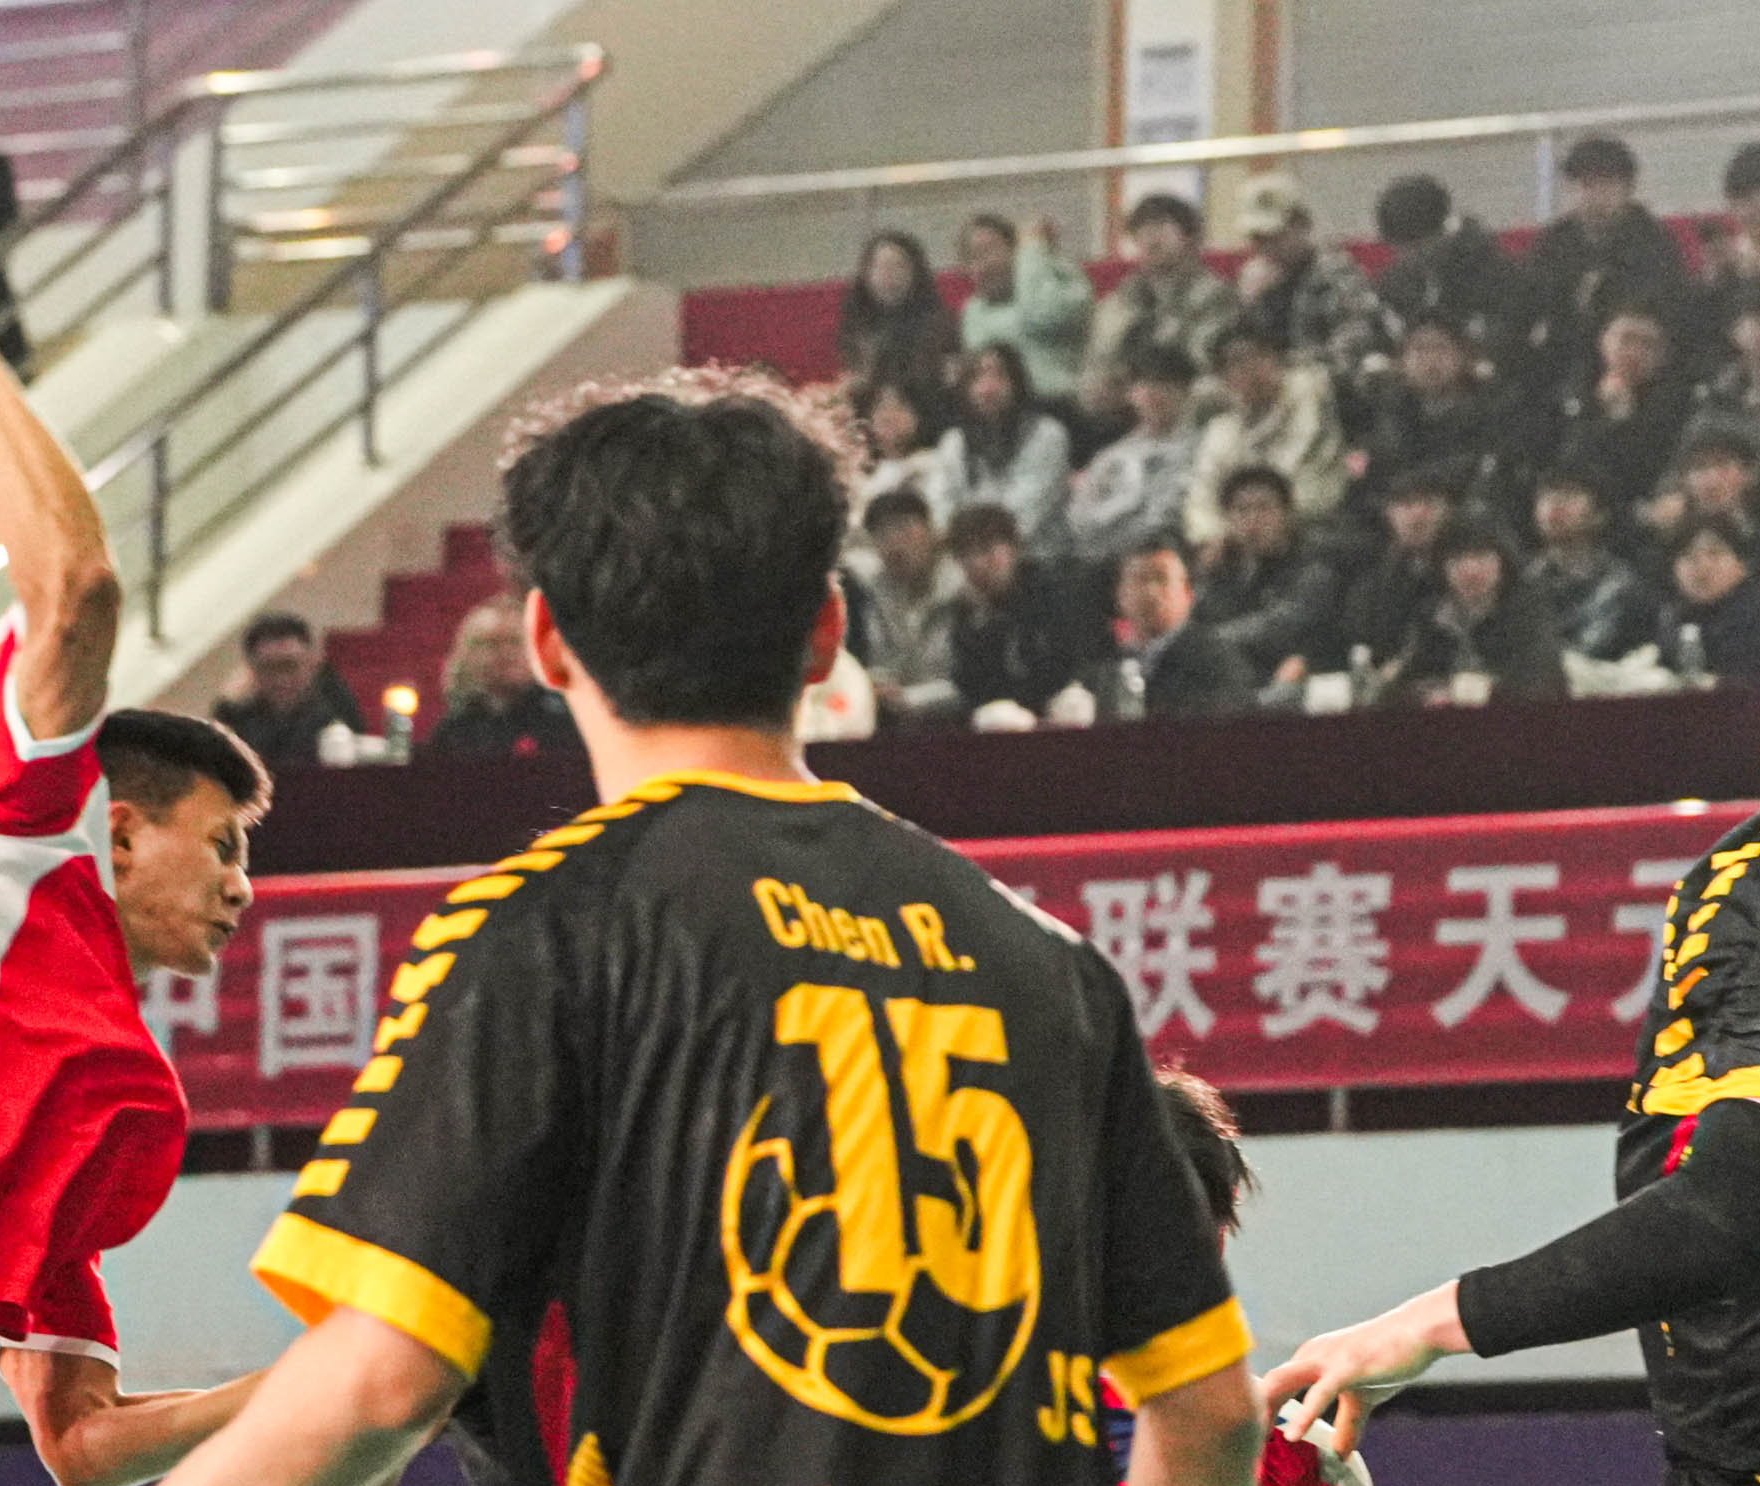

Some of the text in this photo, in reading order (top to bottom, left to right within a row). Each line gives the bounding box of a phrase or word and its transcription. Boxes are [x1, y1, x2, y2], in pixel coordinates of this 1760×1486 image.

[752, 877, 977, 972] Chen R.
[774, 983, 1032, 1312] 15
